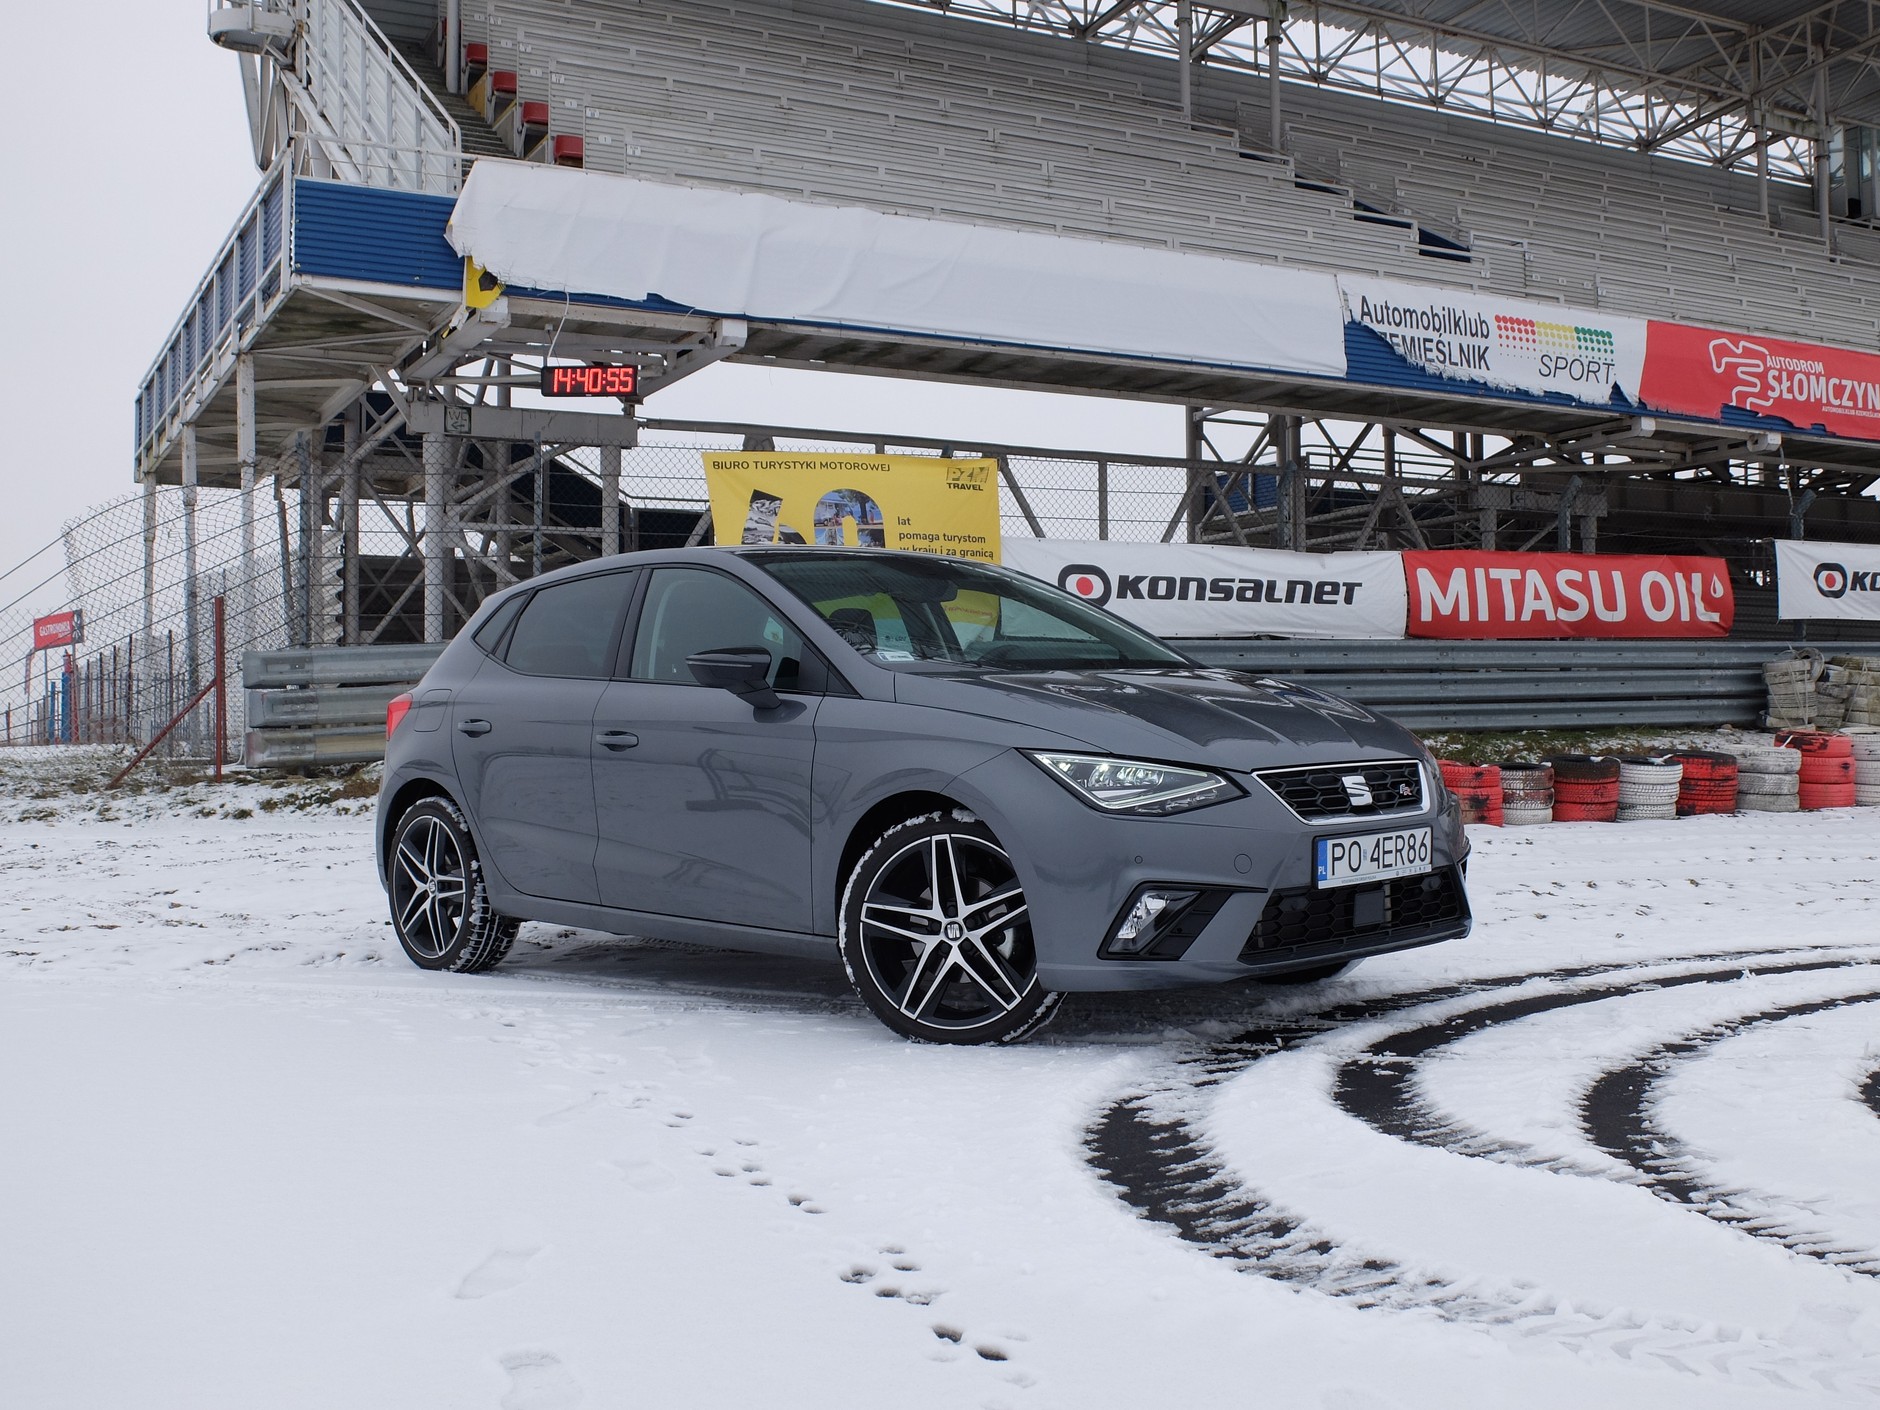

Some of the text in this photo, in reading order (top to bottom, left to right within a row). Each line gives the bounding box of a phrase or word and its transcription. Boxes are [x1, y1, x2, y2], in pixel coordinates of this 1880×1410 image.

[1360, 295, 1490, 339] Automobilklub
[1538, 354, 1615, 384] SPORT
[1766, 355, 1825, 374] AUTODROM
[553, 367, 634, 393] 14:40:55
[1767, 369, 1880, 410] SŁOMCZYN
[712, 460, 891, 472] BIURO TURYSTYKI MOTOROWEJ
[946, 482, 984, 492] TRAVEL
[897, 516, 911, 526] lat
[899, 532, 986, 544] pomaga turystom
[960, 548, 994, 560] granicą
[1416, 567, 1720, 623] MITASU OIL
[1331, 831, 1428, 876] PO 4ER86
[1318, 866, 1327, 875] PL
